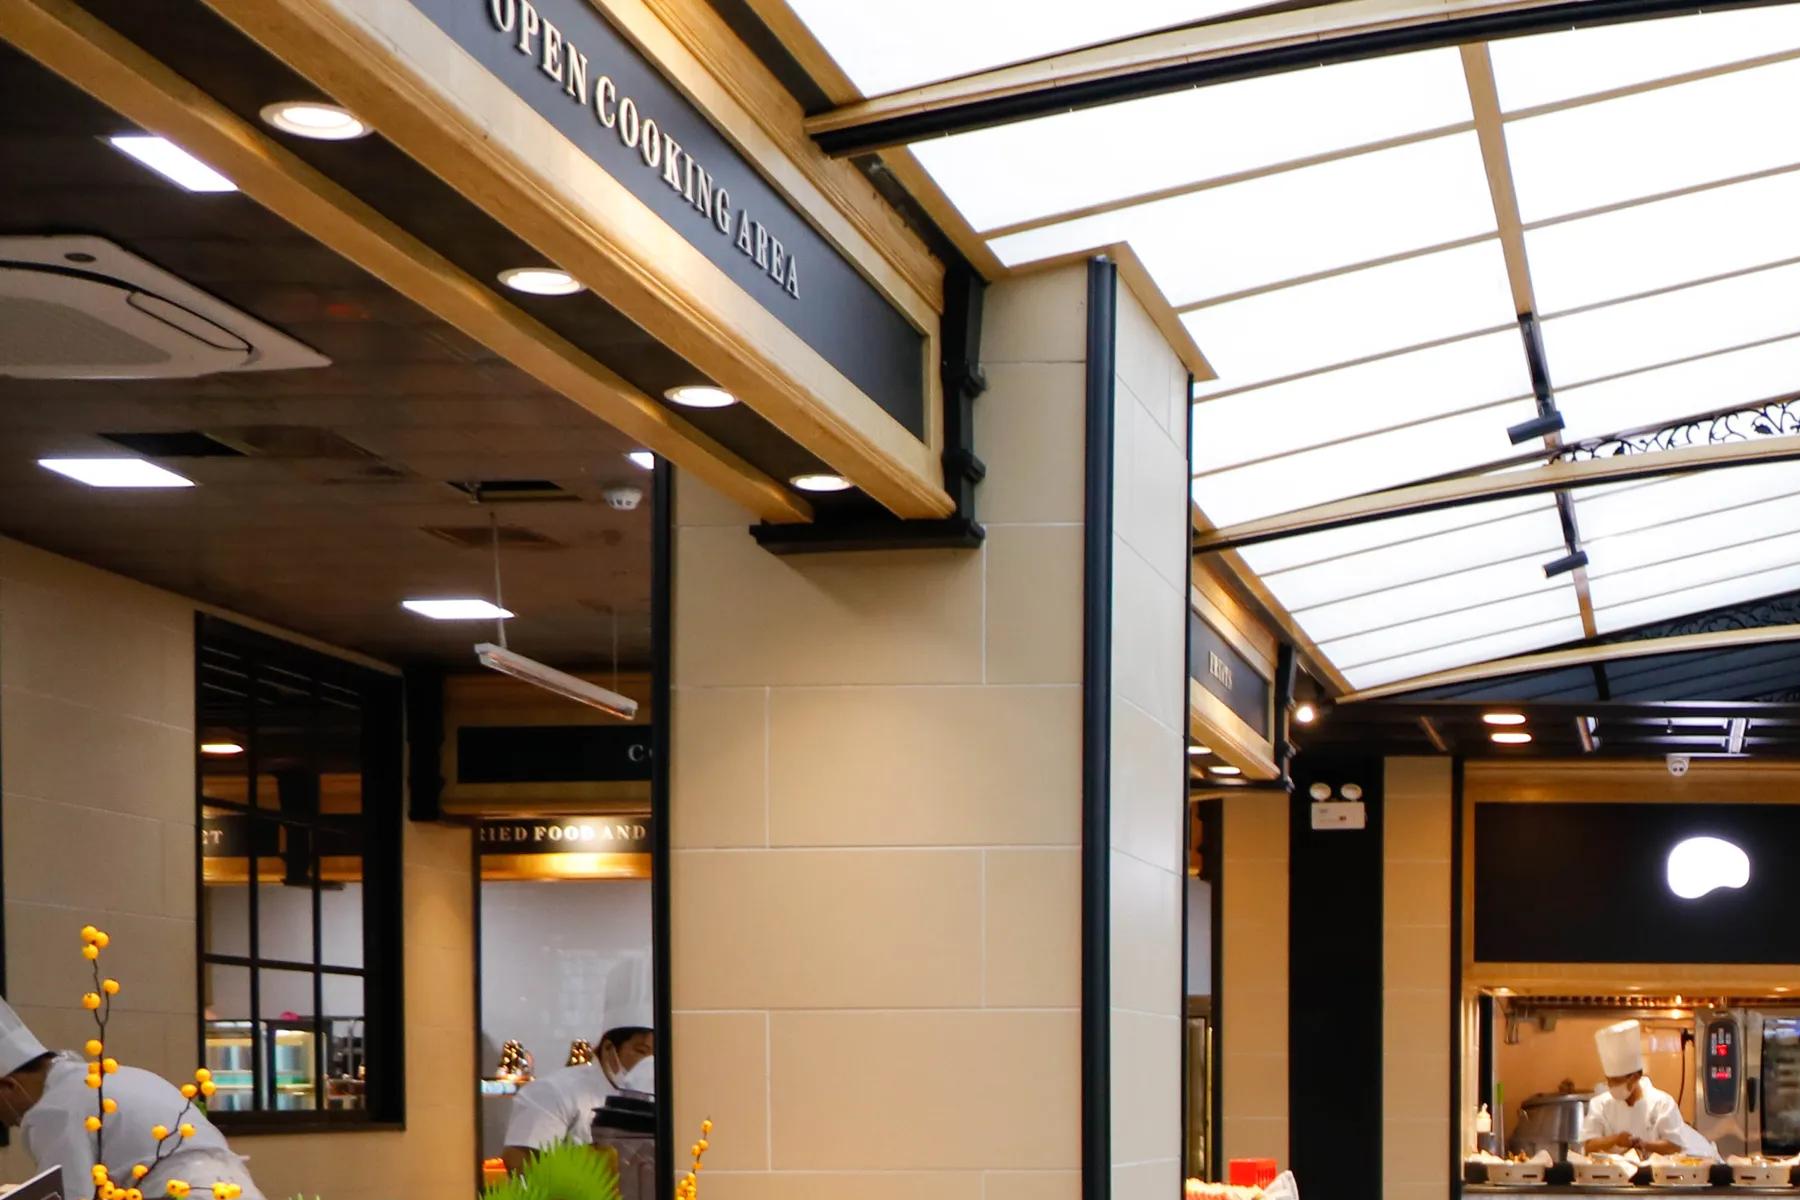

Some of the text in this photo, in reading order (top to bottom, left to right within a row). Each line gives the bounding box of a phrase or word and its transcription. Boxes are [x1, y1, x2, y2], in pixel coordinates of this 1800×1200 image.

[491, 0, 801, 300] OPEN COOKING AREA
[1209, 650, 1233, 690] FRUITS
[534, 825, 596, 841] FOOD
[602, 824, 647, 841] AND
